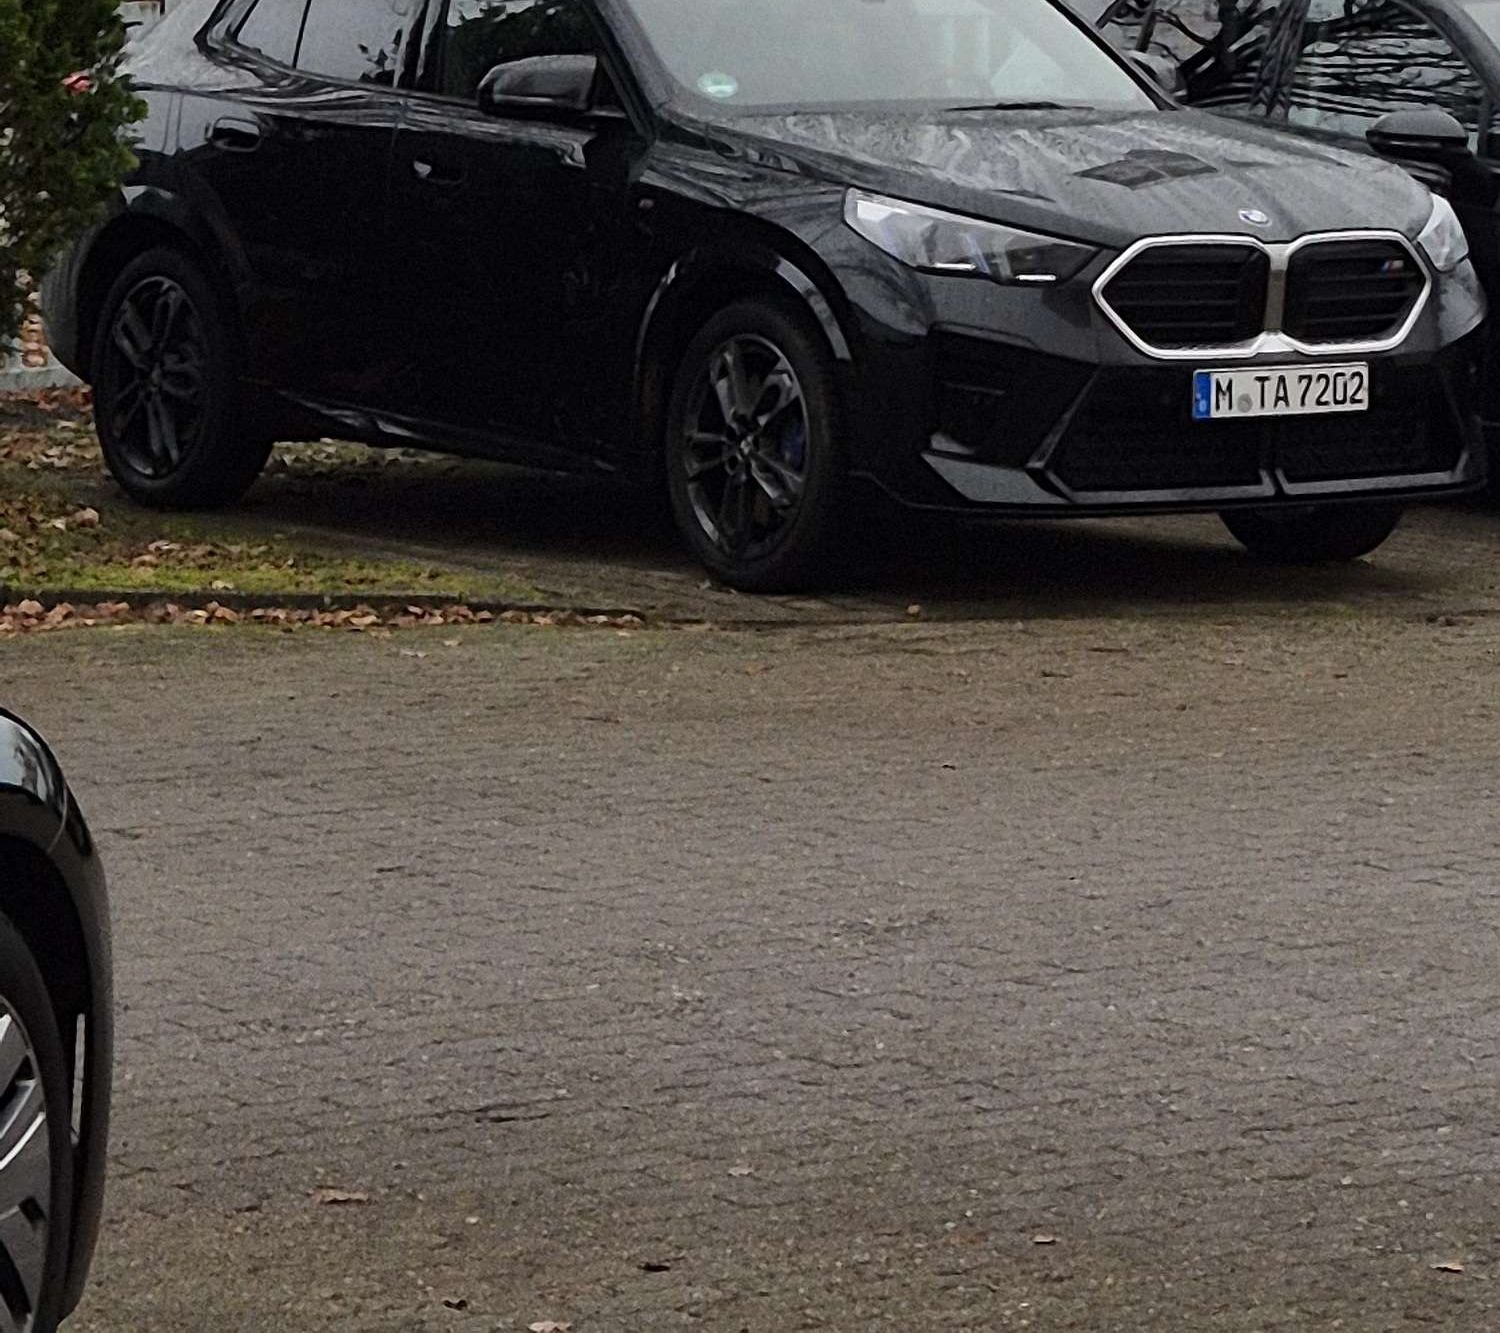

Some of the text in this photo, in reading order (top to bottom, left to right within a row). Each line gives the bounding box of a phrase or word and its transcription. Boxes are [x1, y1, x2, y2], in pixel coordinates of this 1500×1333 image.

[1215, 371, 1364, 412] M TA 7202
